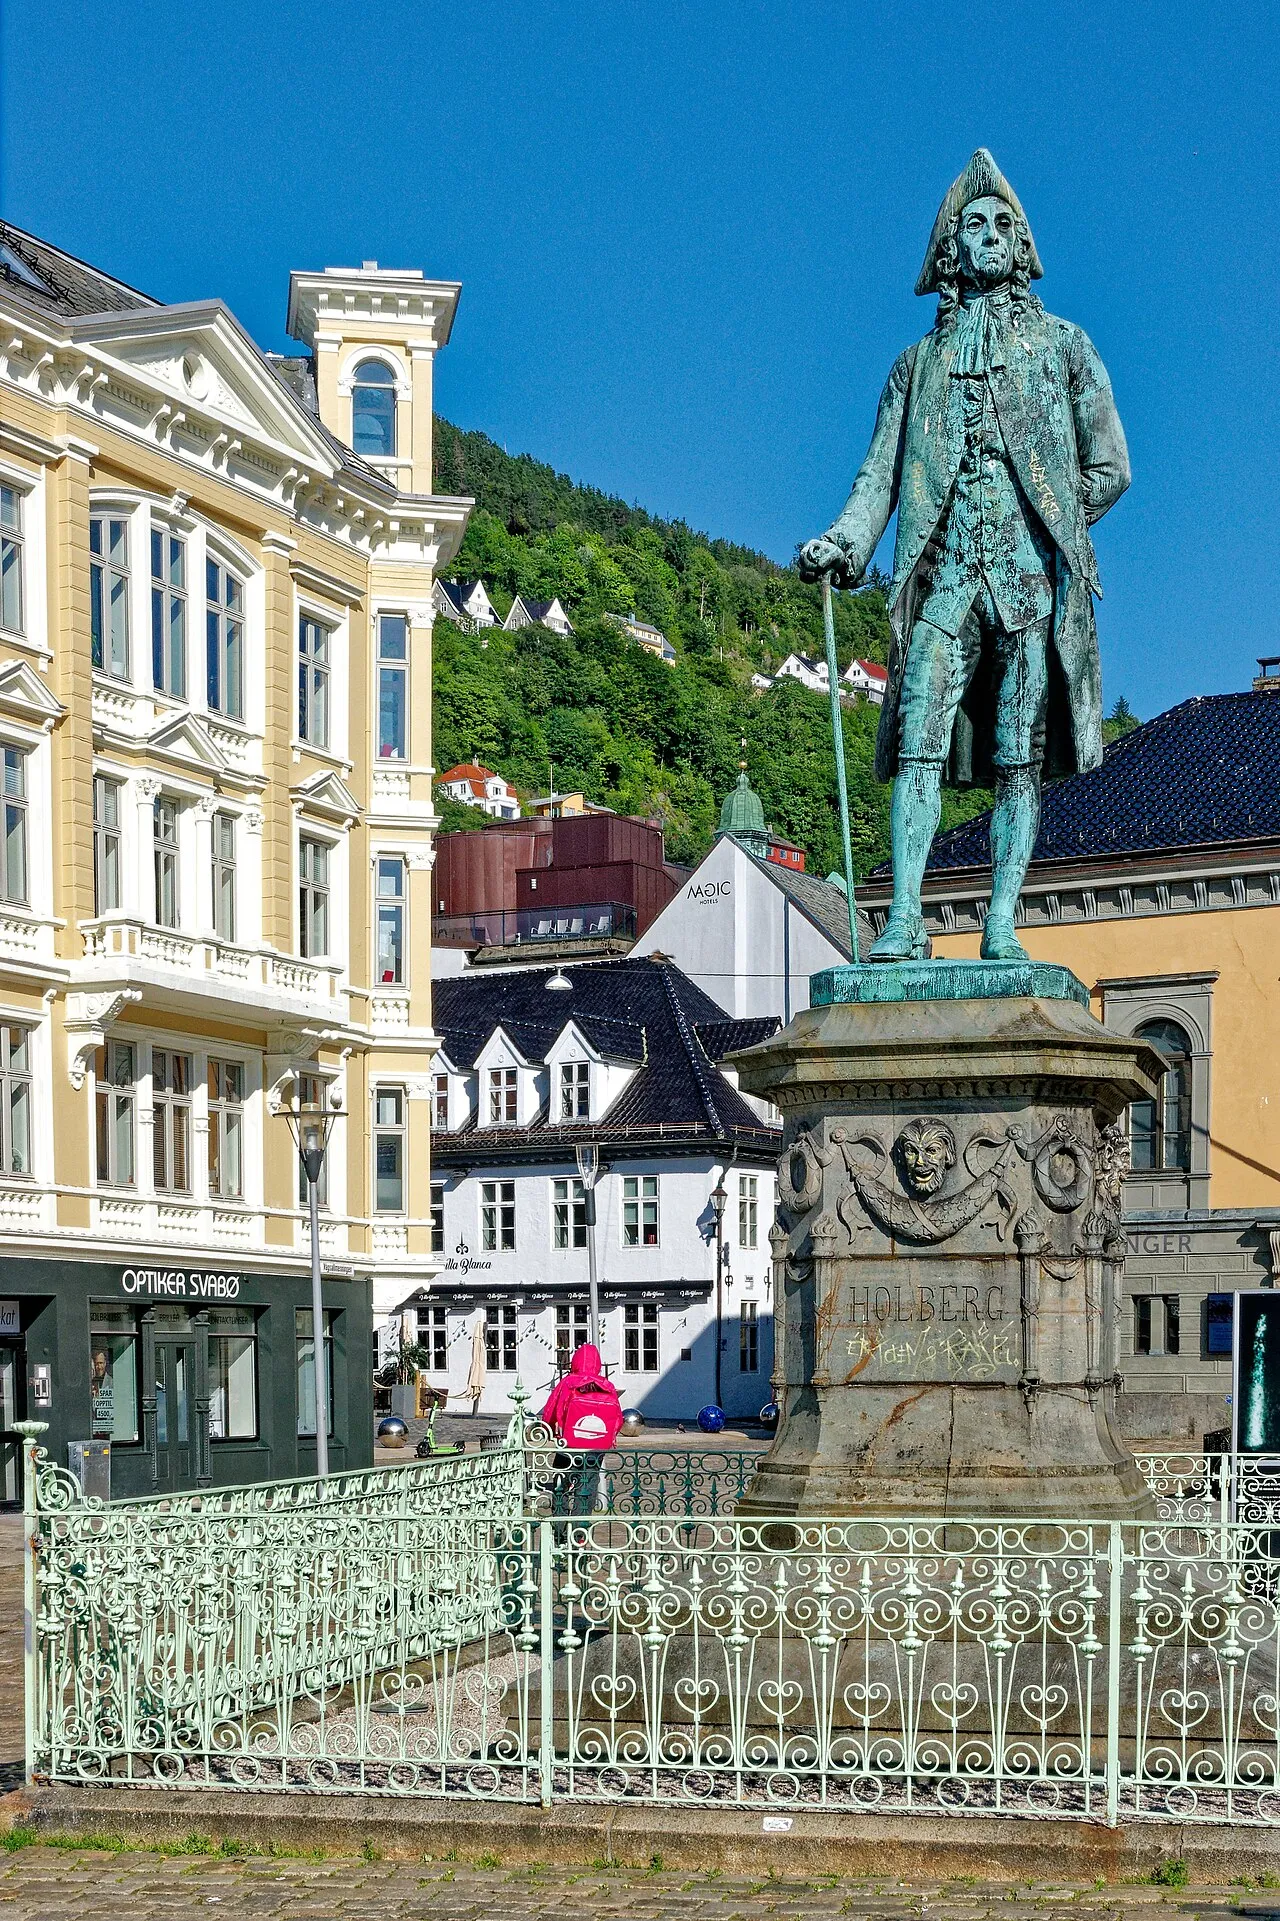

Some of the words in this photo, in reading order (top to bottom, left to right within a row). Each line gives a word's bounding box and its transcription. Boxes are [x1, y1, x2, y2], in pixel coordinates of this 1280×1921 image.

[687, 881, 730, 899] MAGIC
[445, 1257, 458, 1270] illa
[460, 1258, 491, 1275] Blanca
[122, 1269, 186, 1295] OPTIKER
[190, 1273, 240, 1298] SVABØ
[848, 1286, 1003, 1322] HOLBERG
